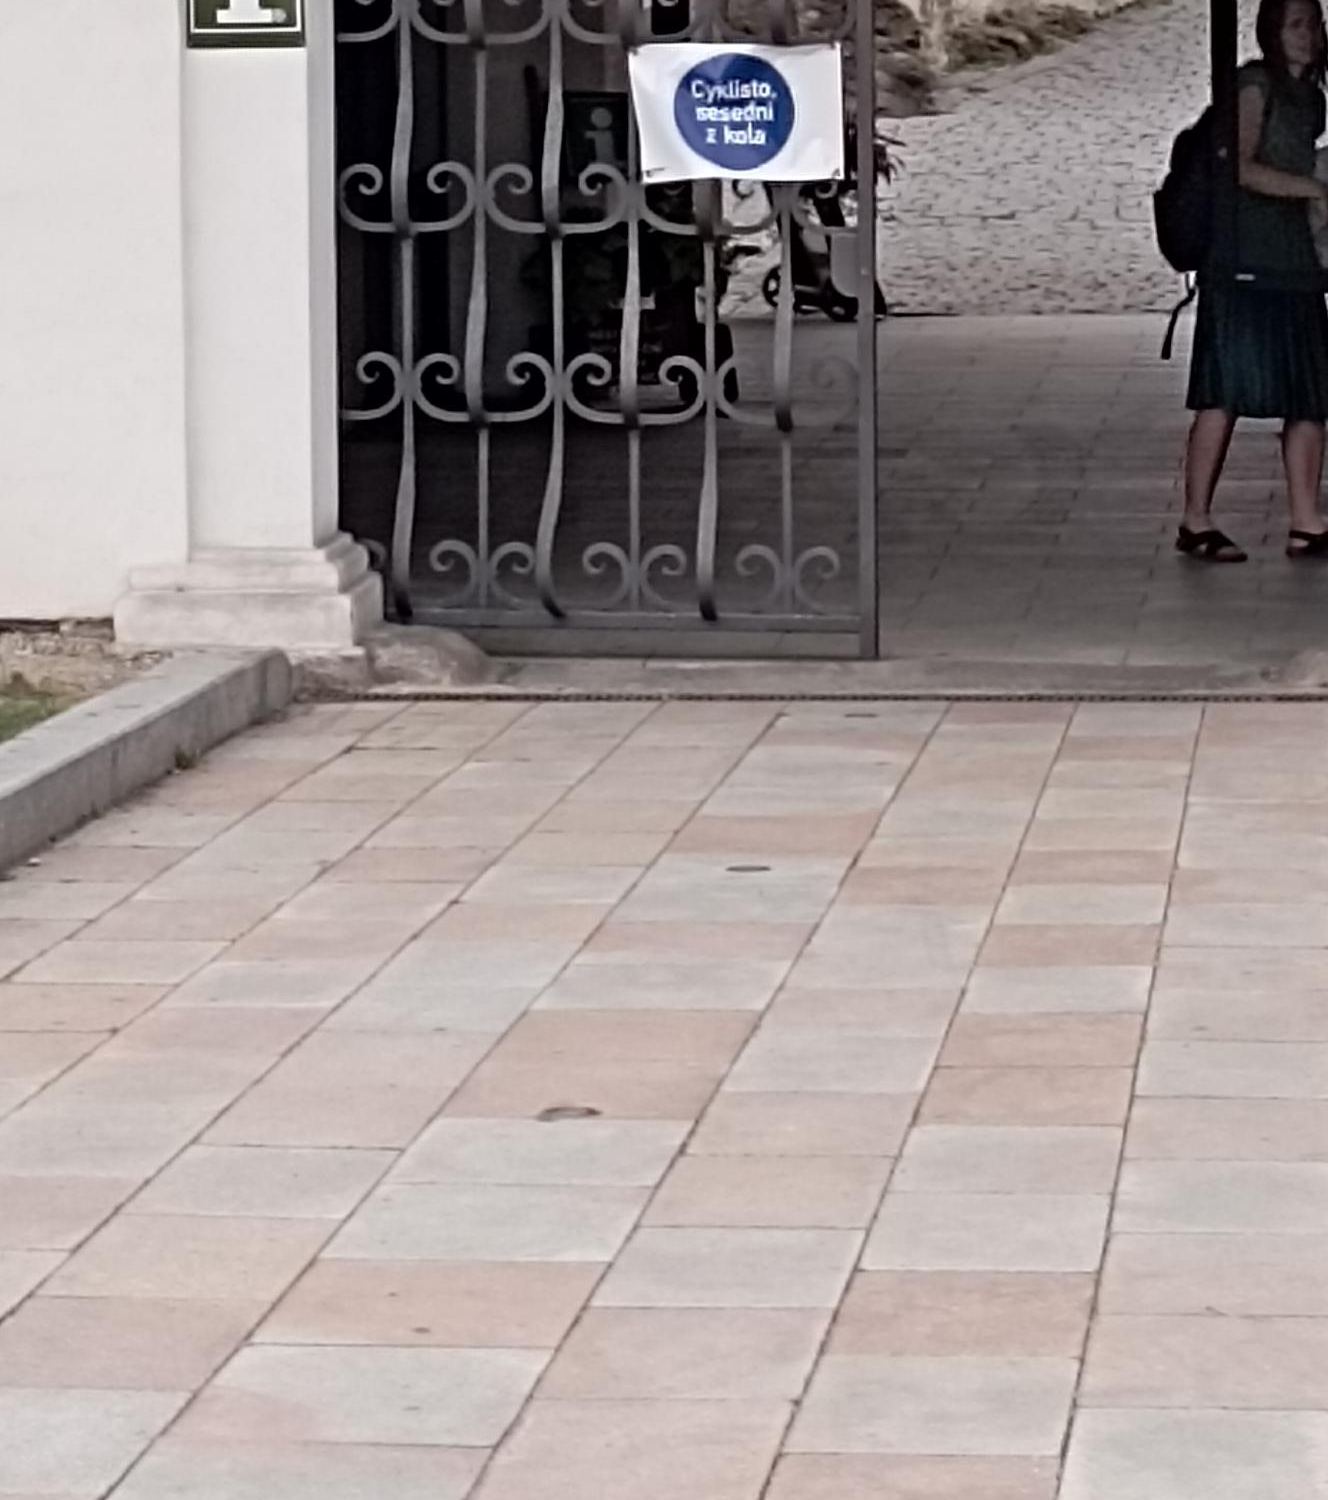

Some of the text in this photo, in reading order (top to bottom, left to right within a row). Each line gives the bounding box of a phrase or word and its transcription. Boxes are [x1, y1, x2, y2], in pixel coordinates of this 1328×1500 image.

[696, 100, 774, 121] sesedni
[706, 121, 766, 145] z kola
